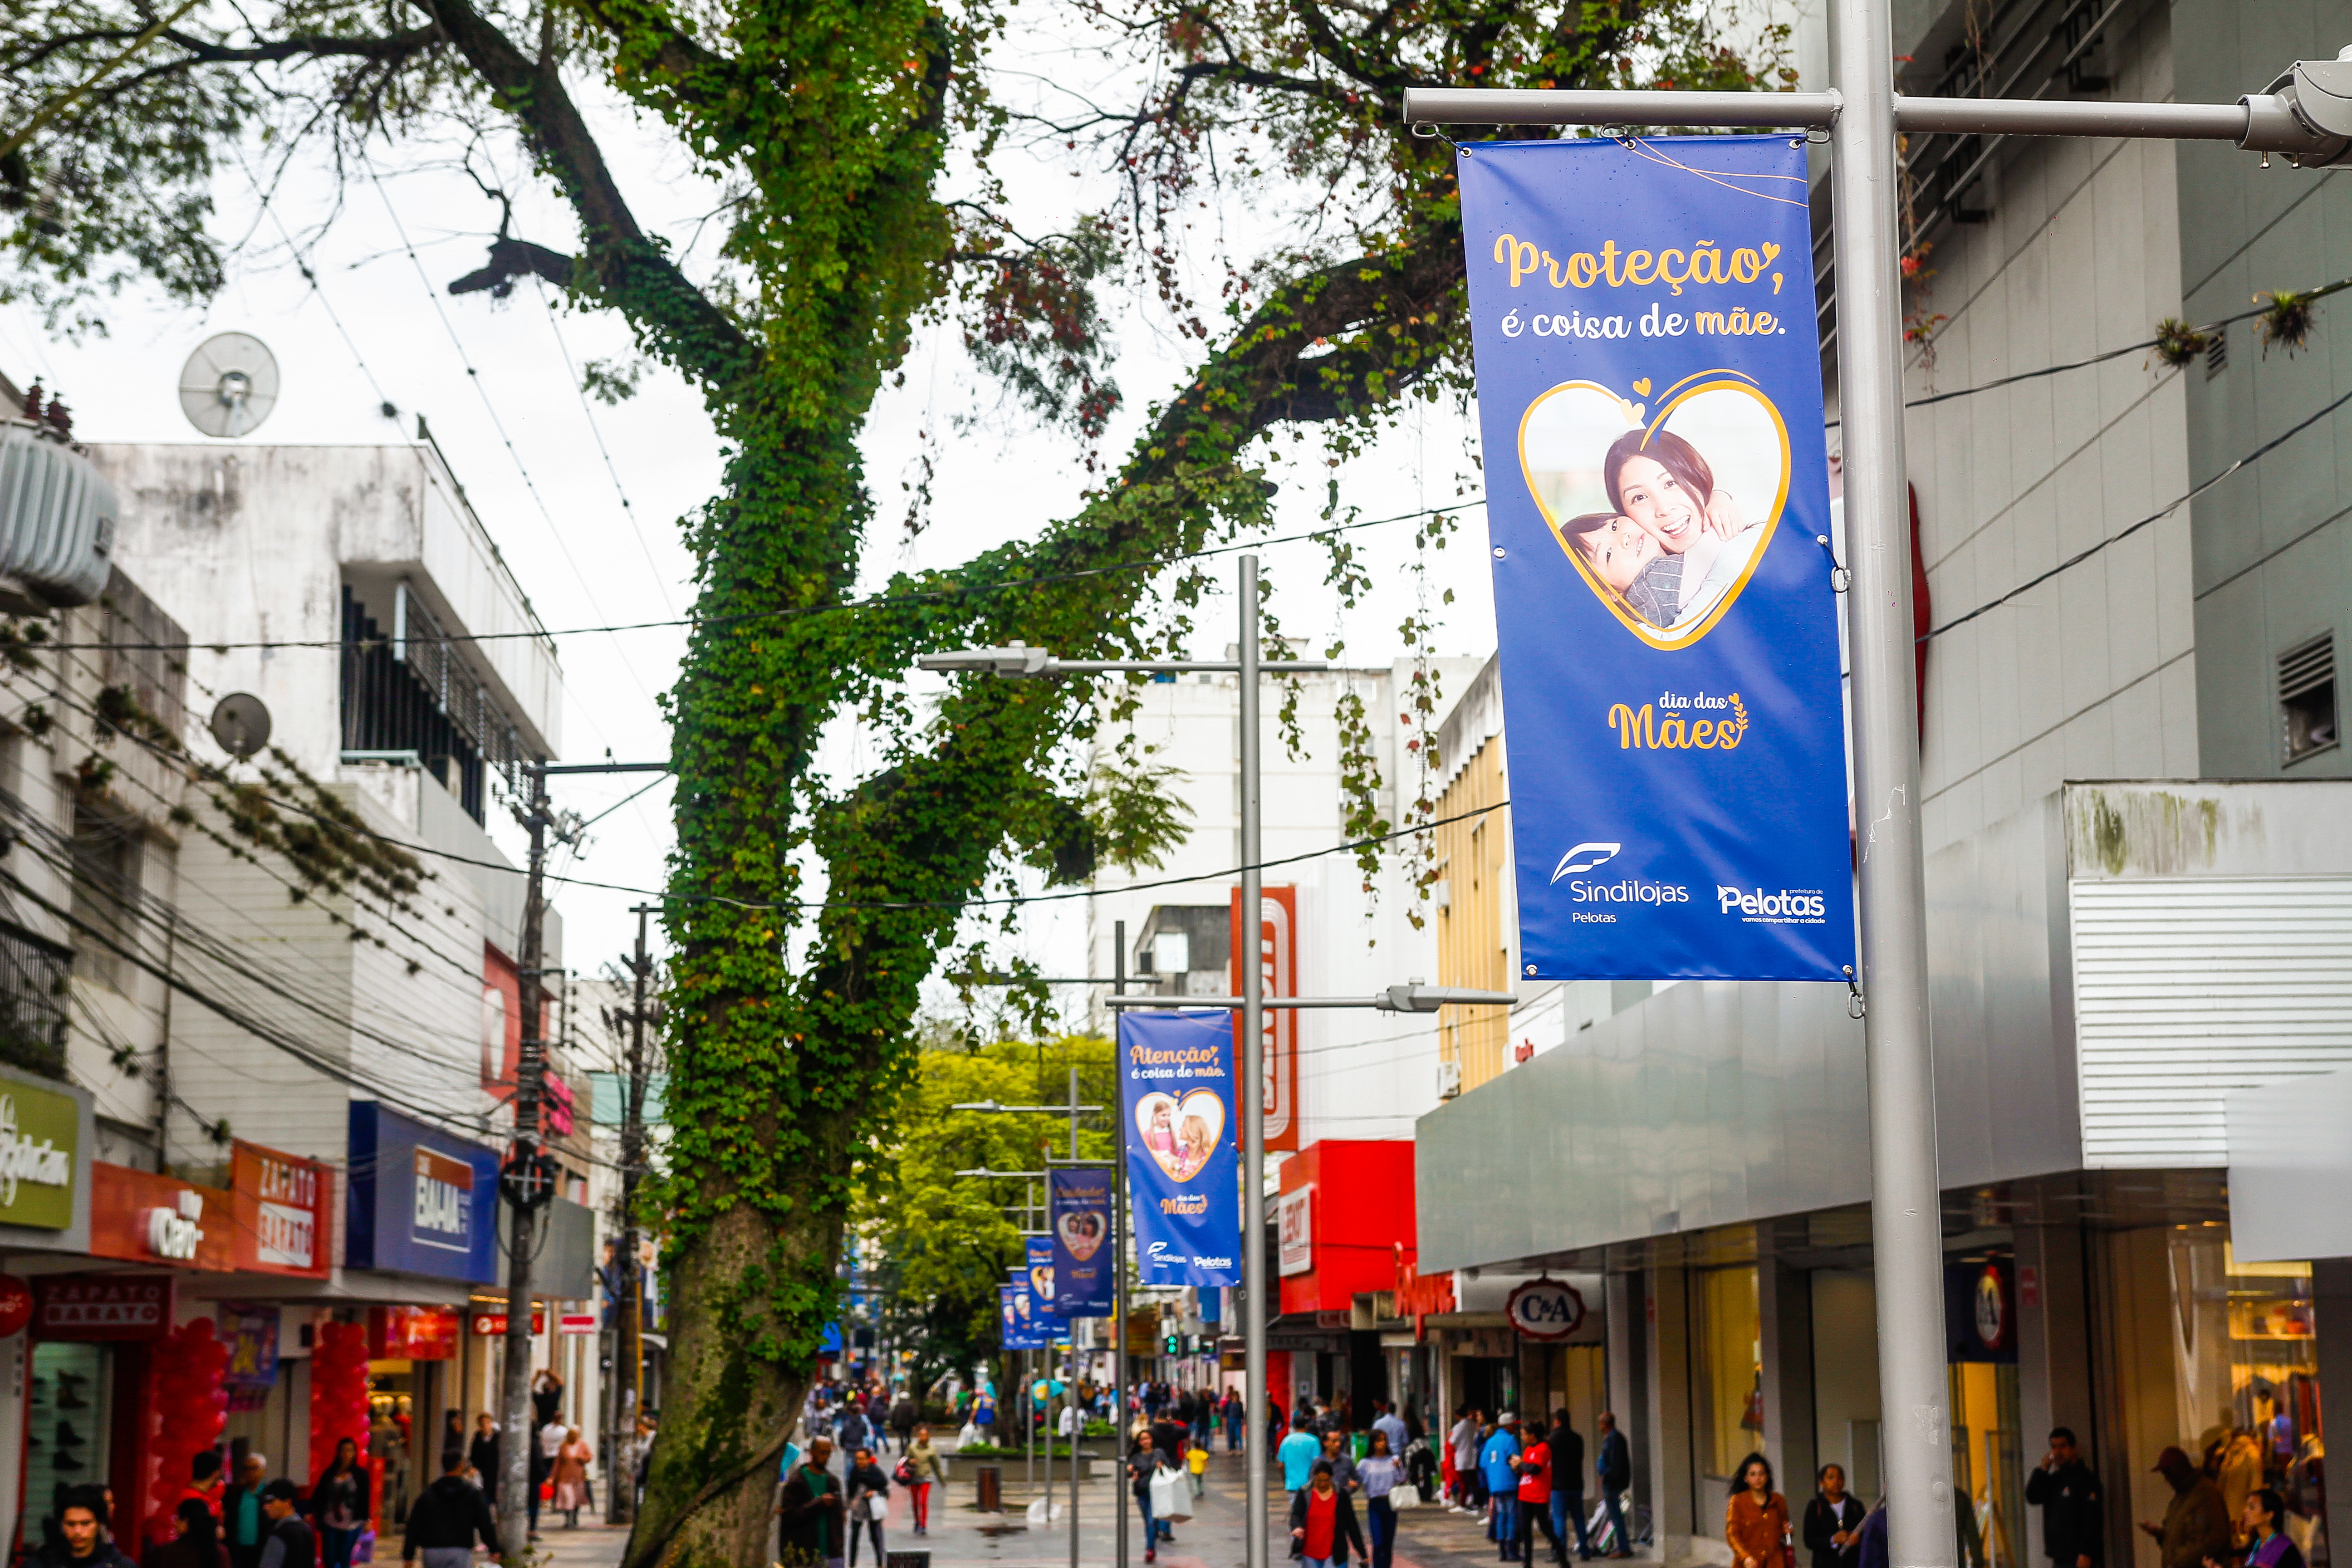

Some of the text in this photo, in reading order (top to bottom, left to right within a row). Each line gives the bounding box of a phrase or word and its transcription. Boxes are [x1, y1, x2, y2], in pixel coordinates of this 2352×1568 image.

[1494, 233, 1784, 296] Proteção,
[1501, 302, 1787, 340] é coisa de mãe.
[1659, 691, 1728, 709] dia das
[1608, 703, 1744, 750] Mães
[1570, 880, 1690, 906] Sindilojas
[1719, 886, 1826, 916] Pelotas
[1572, 911, 1617, 923] Pelotas
[1176, 1063, 1194, 1078] de
